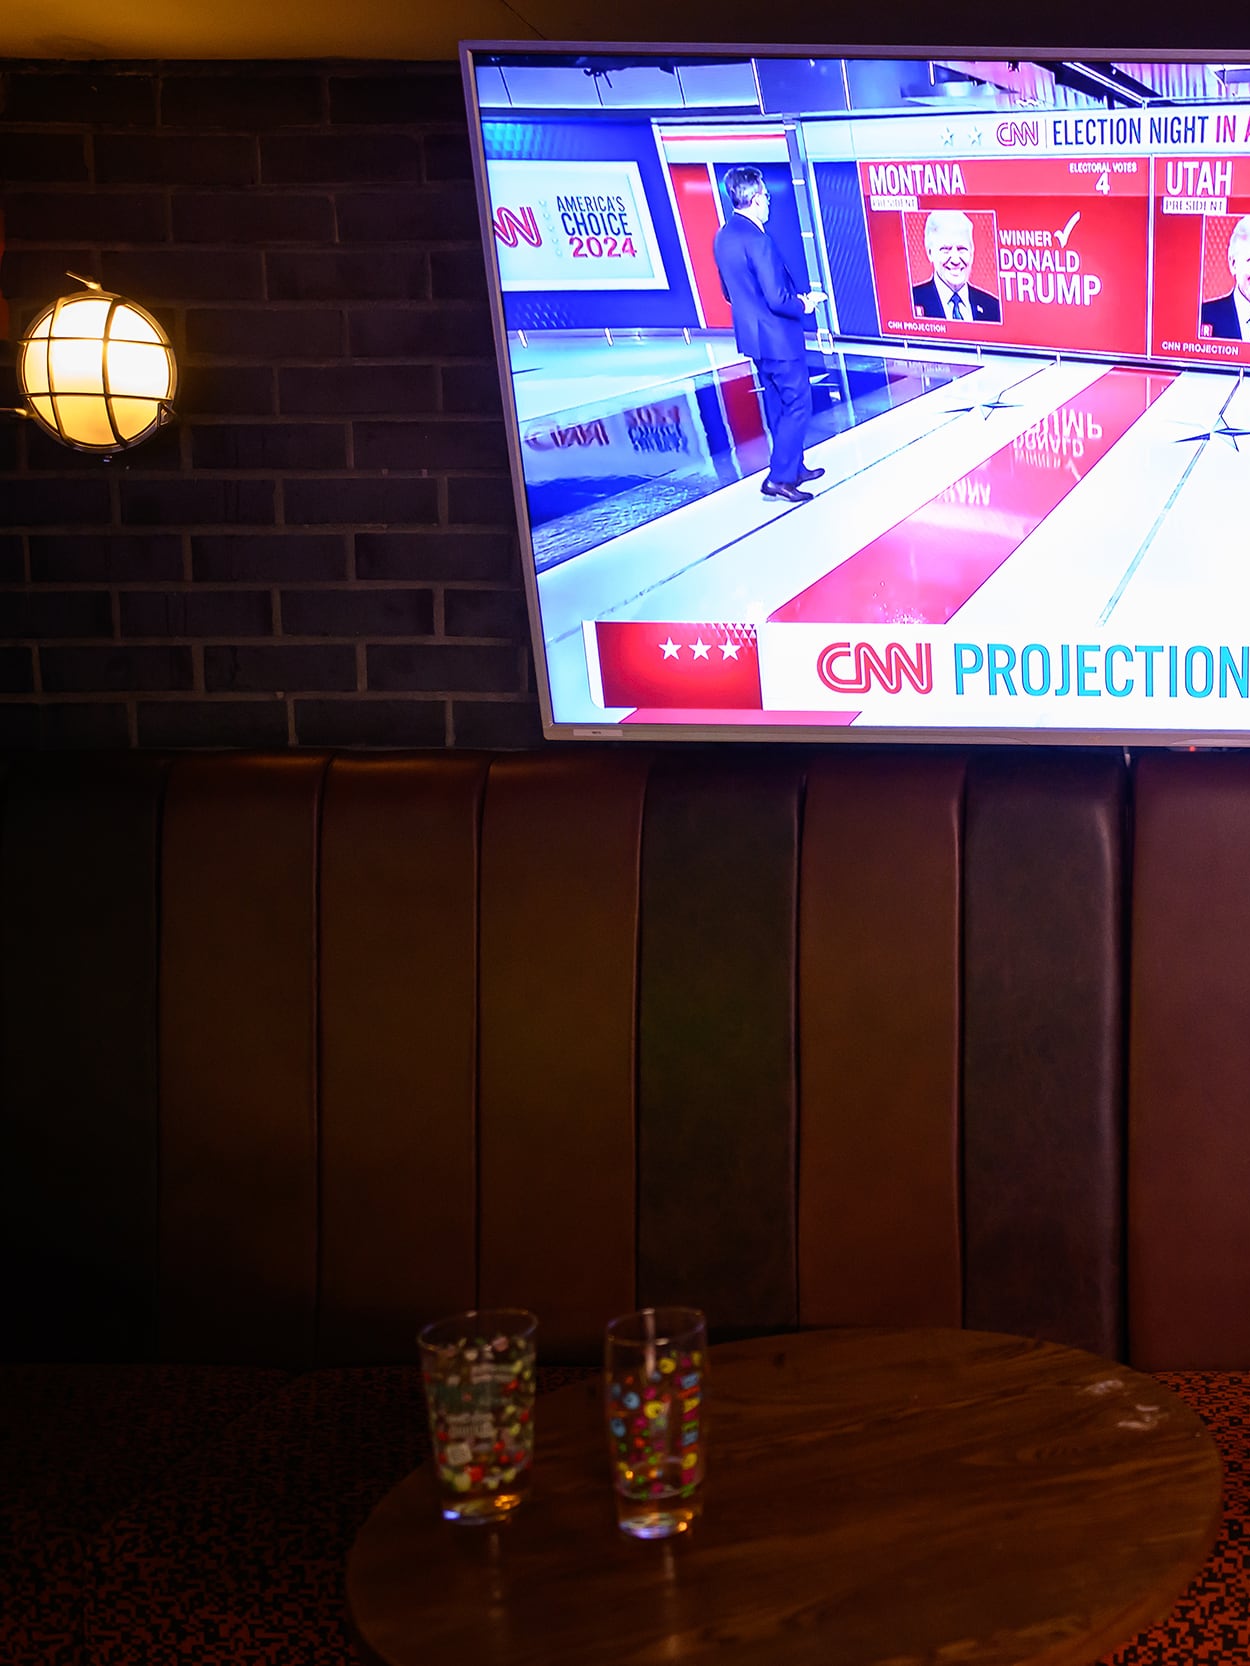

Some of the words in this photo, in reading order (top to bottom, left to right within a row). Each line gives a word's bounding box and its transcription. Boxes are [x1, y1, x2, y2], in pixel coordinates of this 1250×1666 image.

[996, 121, 1040, 146] CNN
[1053, 117, 1143, 146] ELECTION
[1149, 115, 1209, 144] NIGHT
[1215, 115, 1237, 143] IN
[868, 163, 967, 195] MONTANA
[1069, 162, 1111, 173] ELECTORAL
[1112, 162, 1137, 173] VOTES
[1166, 161, 1233, 196] UTAH
[1095, 172, 1110, 195] 4
[556, 195, 626, 213] AMERICA'S
[1165, 200, 1223, 211] PRESIDENT
[562, 212, 633, 237] CHOICE
[568, 236, 638, 258] 2024
[999, 230, 1053, 248] WINNER
[999, 248, 1081, 273] DONALD
[1000, 271, 1102, 307] TRUMP
[904, 322, 947, 333] PROJECTION
[1161, 341, 1181, 351] CNN
[1182, 342, 1239, 356] PROJECTION
[816, 641, 934, 695] CNN
[953, 642, 1250, 699] PROJECTION
